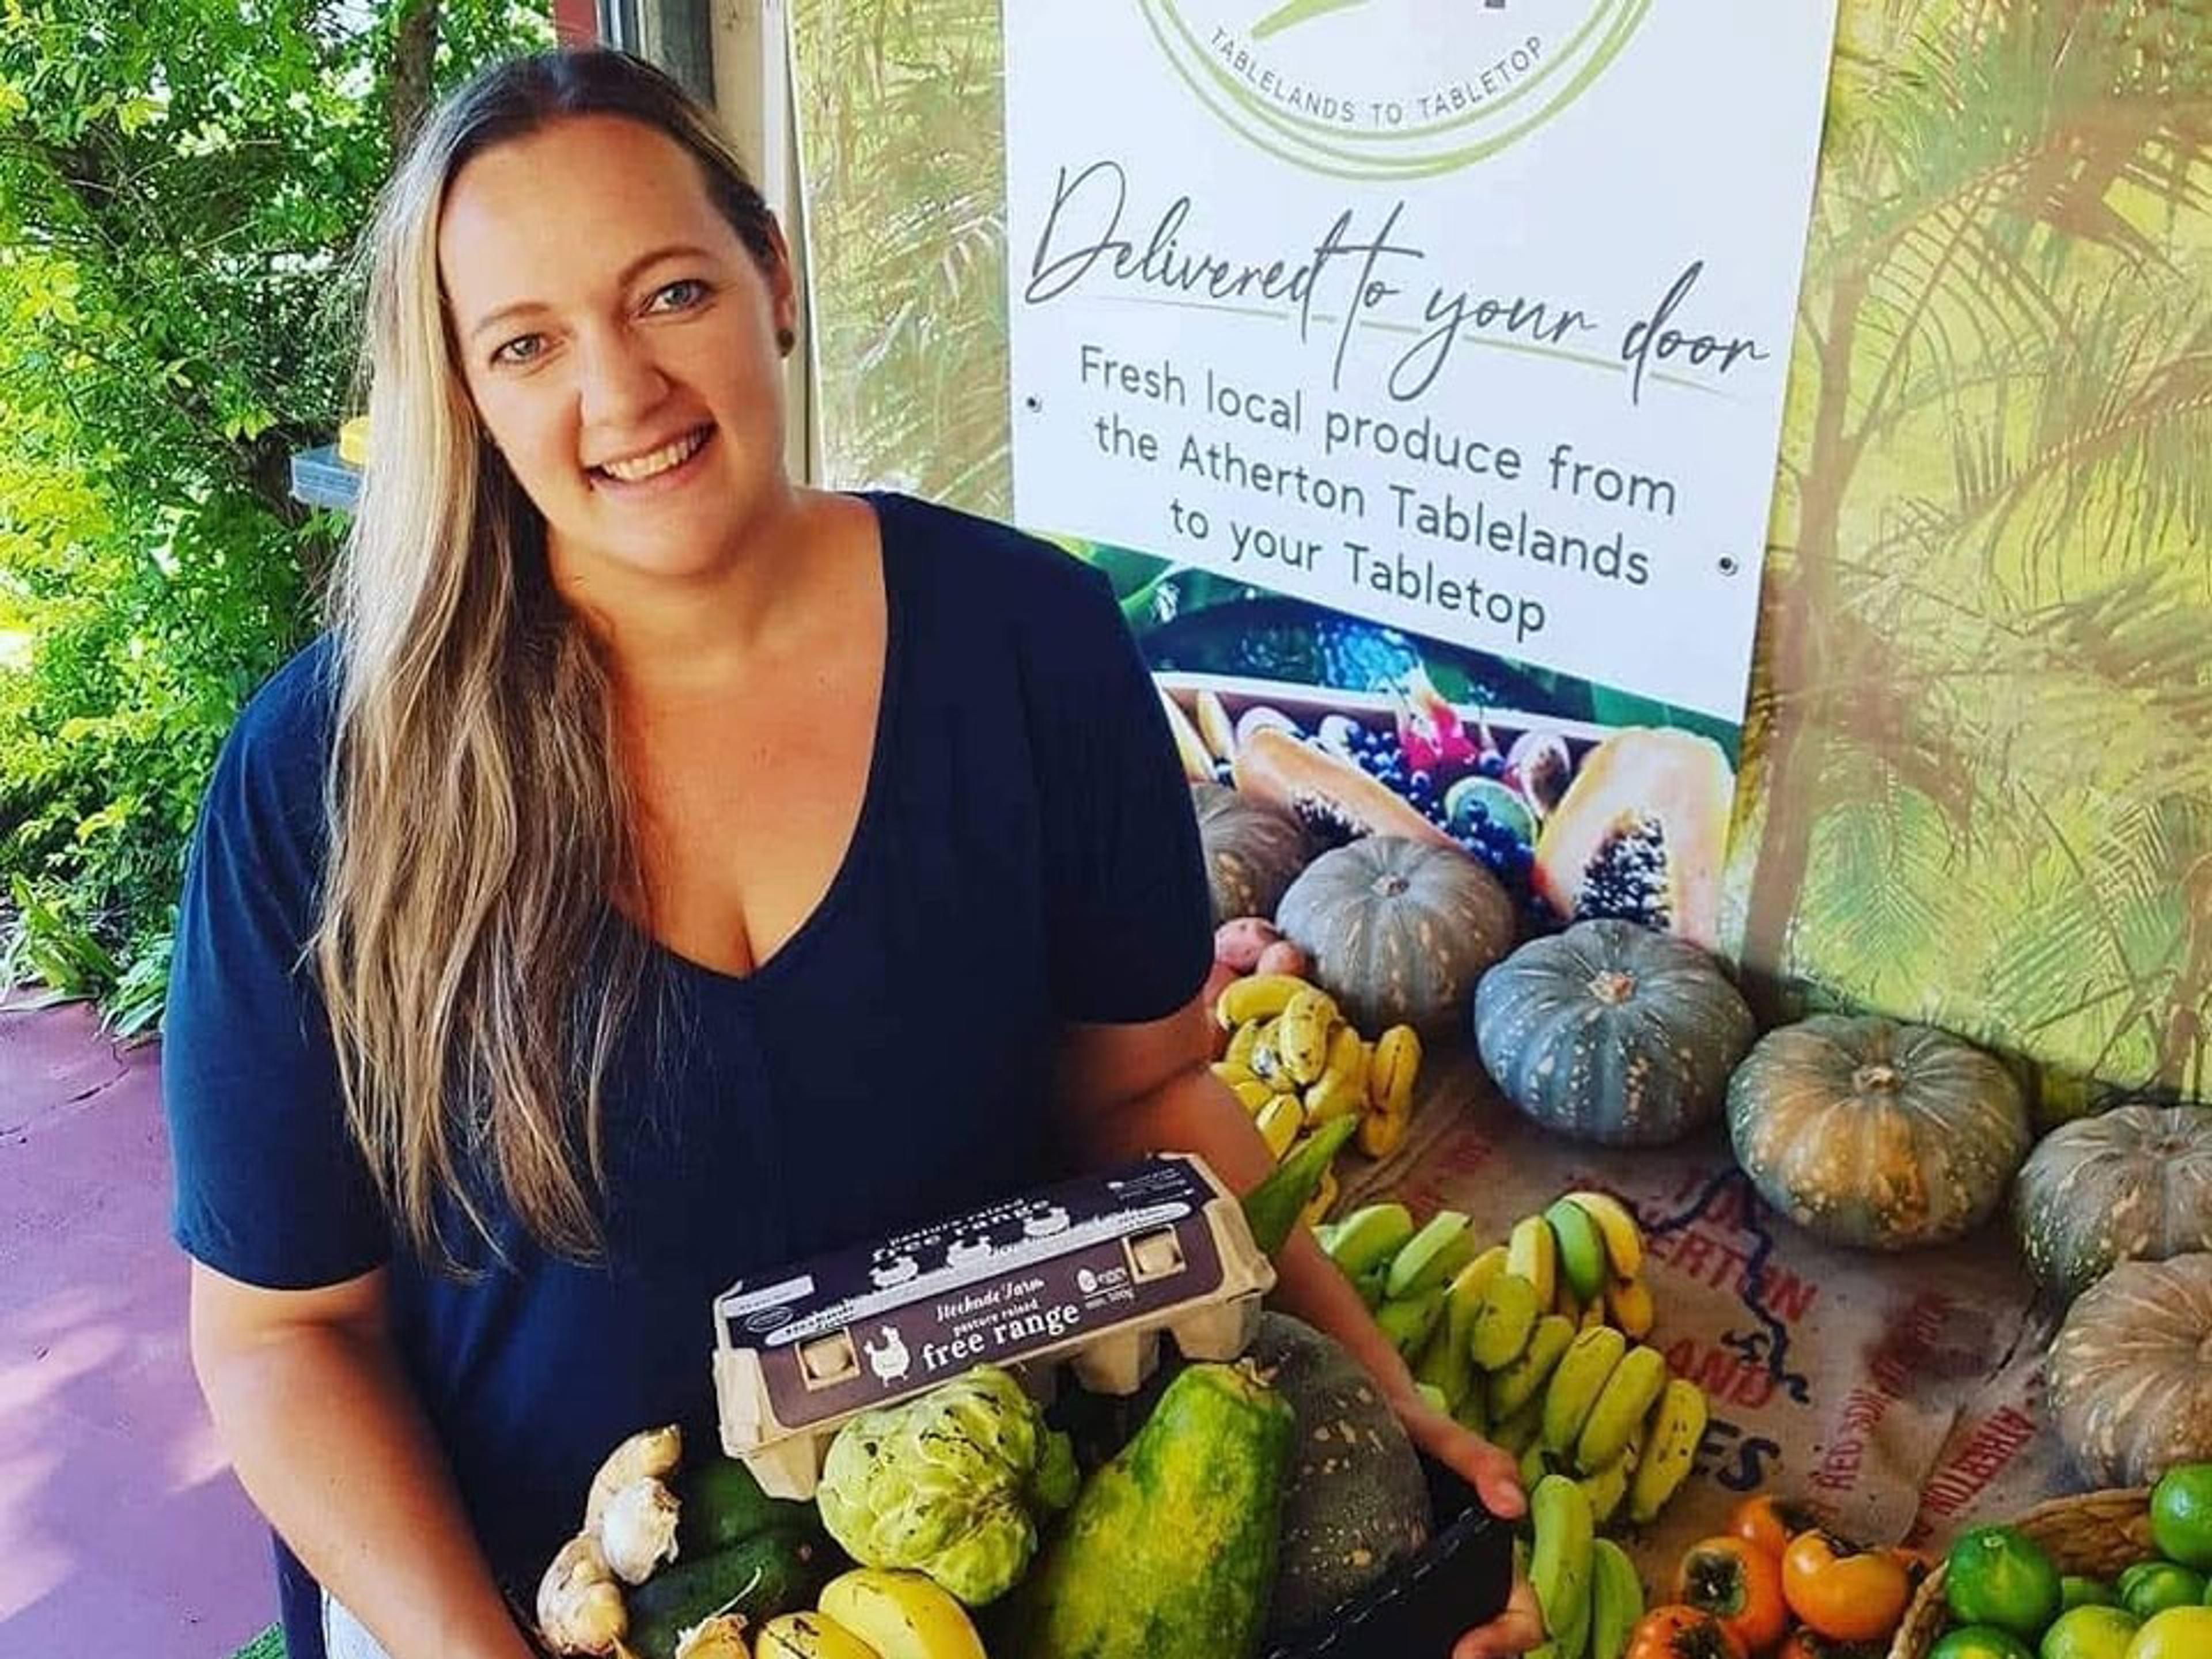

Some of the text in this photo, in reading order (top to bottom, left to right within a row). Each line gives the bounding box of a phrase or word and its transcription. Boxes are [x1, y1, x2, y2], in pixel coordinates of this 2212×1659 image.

[1210, 26, 1542, 125] TABLELANDS TO TABLETOP
[1025, 160, 1771, 405] Delivered to your door
[1080, 344, 1677, 517] Fresh local produce from
[1094, 411, 1650, 586] the Atherton Tablelands
[1169, 497, 1546, 644] to your Tabletop
[921, 1302, 1081, 1372] free range
